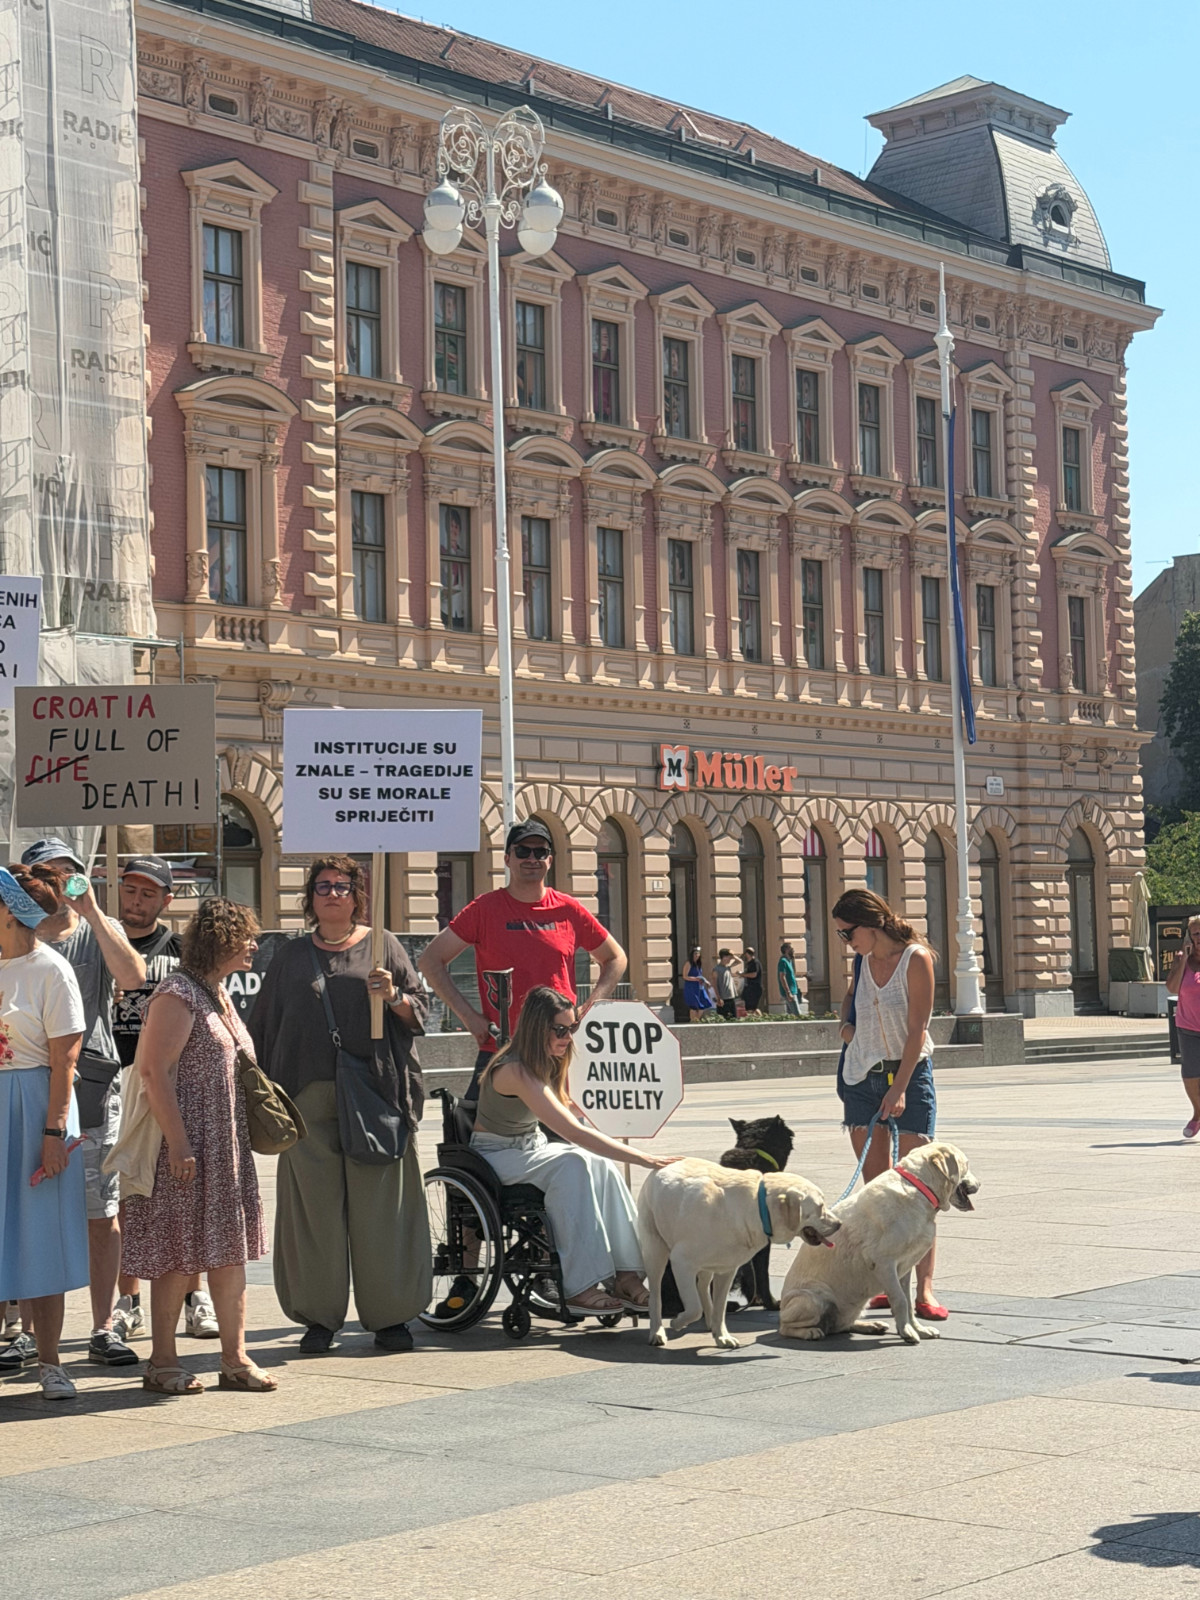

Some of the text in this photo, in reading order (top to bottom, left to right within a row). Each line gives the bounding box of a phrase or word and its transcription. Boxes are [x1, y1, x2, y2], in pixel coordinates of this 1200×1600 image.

[32, 693, 156, 720] CROATIA
[49, 728, 180, 753] FULL OF
[314, 741, 457, 755] INSTITUCIJE SU
[295, 764, 355, 777] ZNALE
[373, 764, 474, 777] TRAGEDIJE
[693, 750, 798, 792] Müller
[82, 778, 200, 810] DEATH!
[318, 787, 451, 800] SU SE MORALE
[335, 807, 434, 823] SPRIJEČITI
[585, 1020, 663, 1055] STOP
[586, 1061, 661, 1083] ANIMAL
[582, 1089, 664, 1111] CRUELTY
